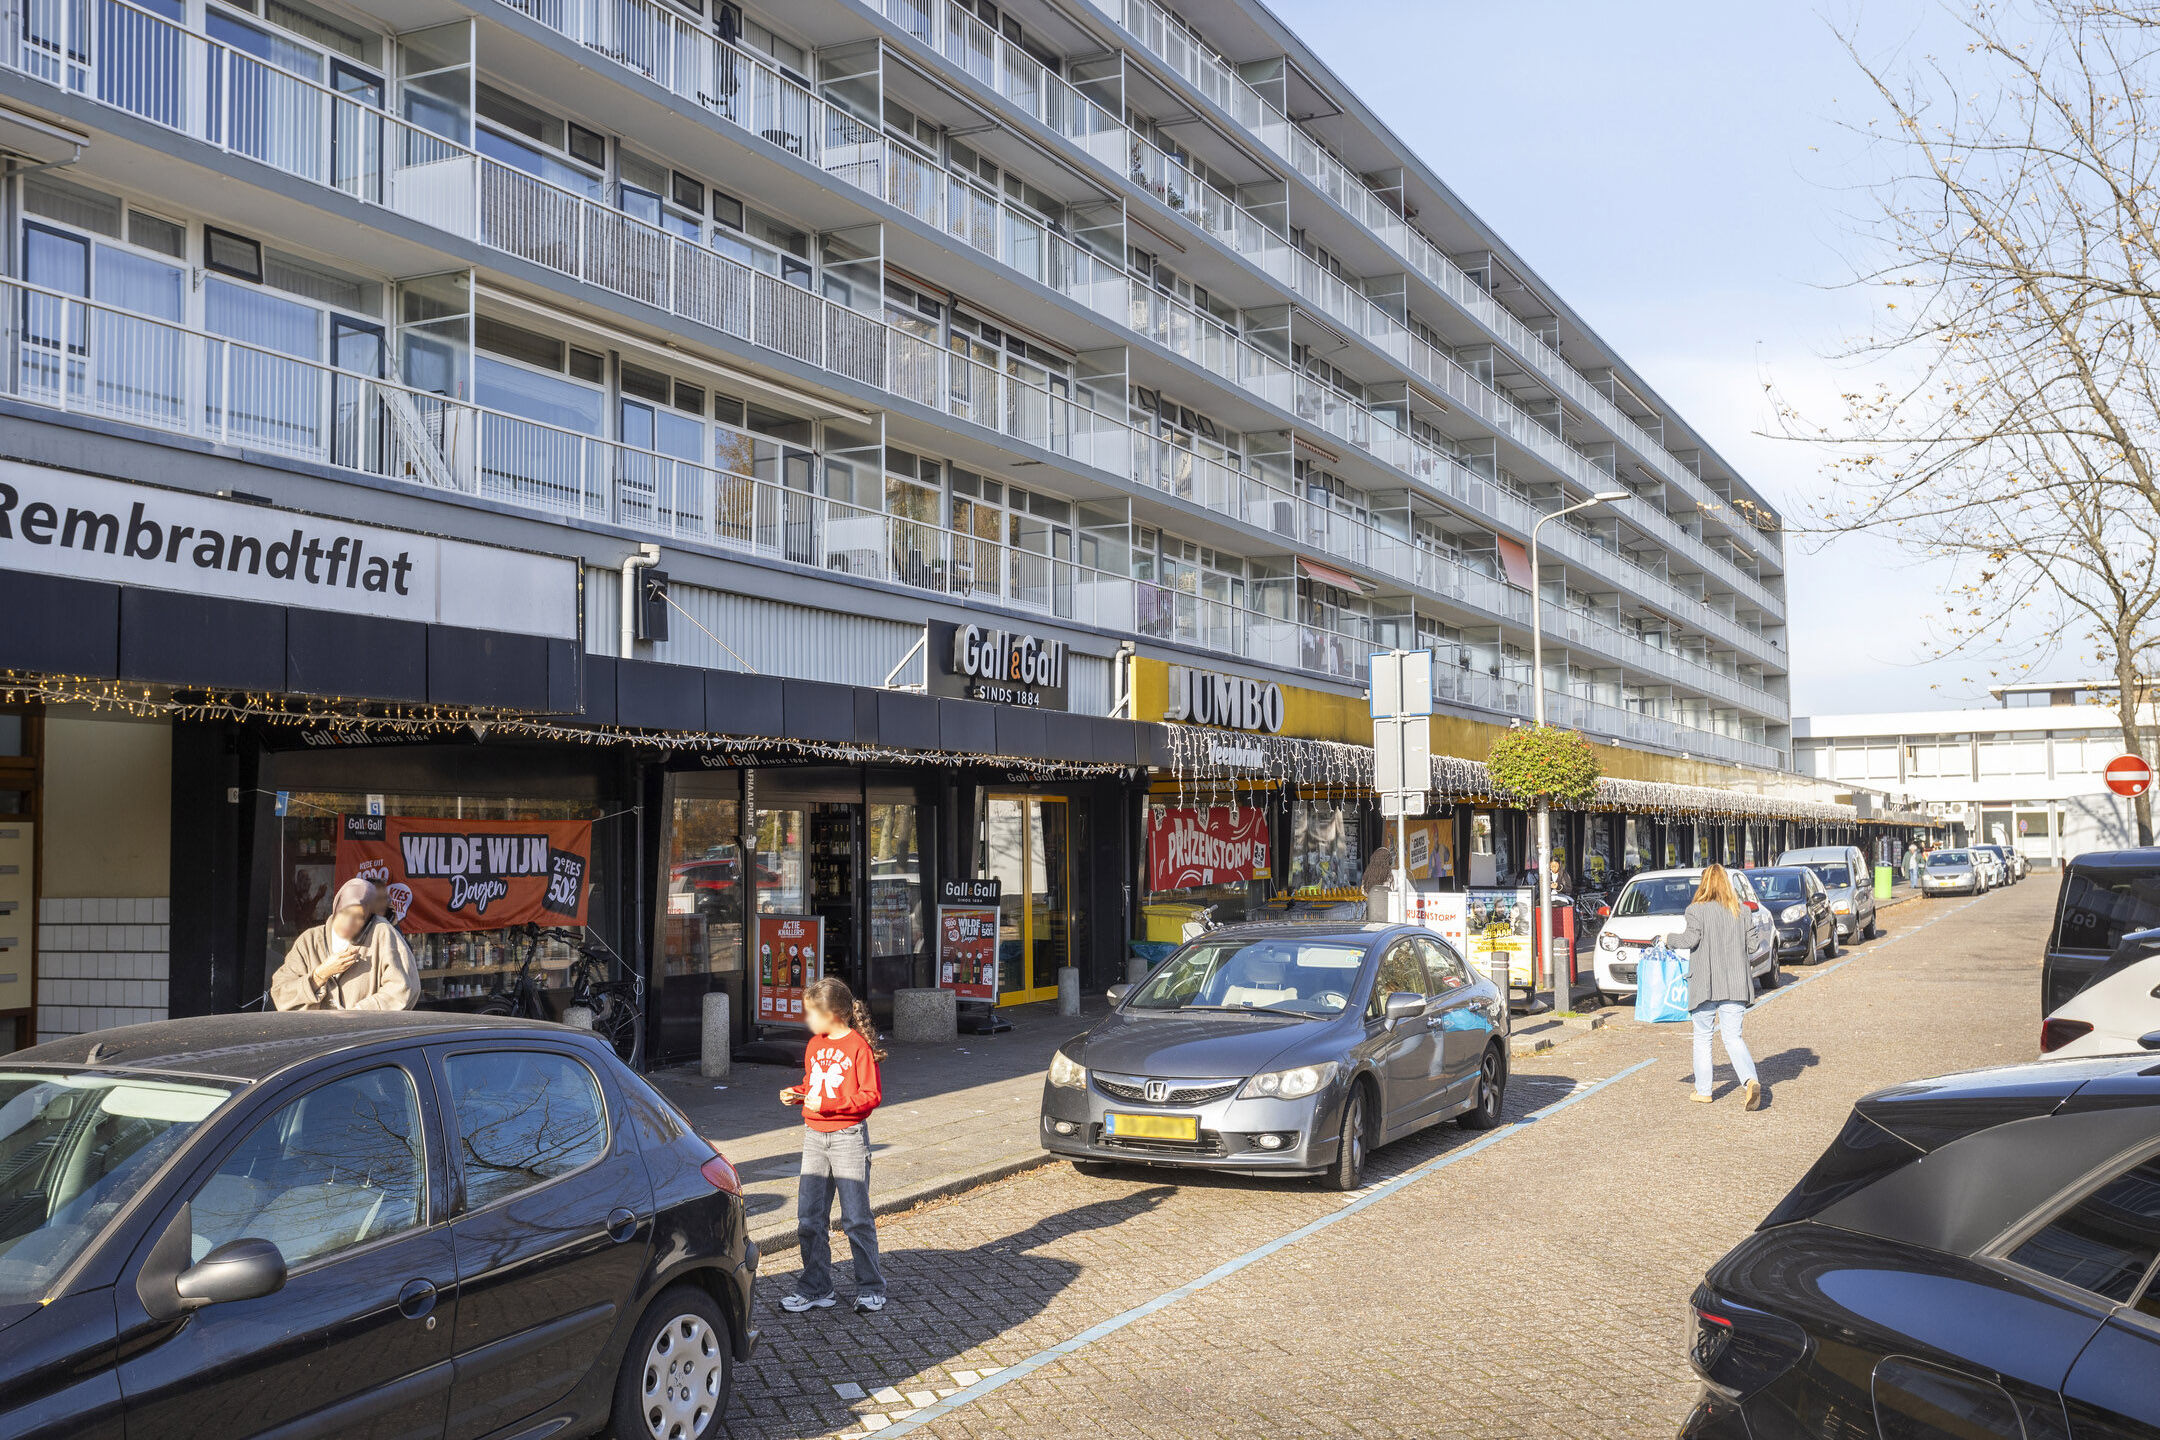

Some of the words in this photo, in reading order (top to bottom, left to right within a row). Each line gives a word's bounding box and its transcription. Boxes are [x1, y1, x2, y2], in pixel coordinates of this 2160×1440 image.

[0, 482, 413, 596] Rembrandtflat
[980, 686, 1012, 702] SINDS
[1016, 691, 1040, 706] 1884
[1170, 665, 1285, 733] JUMBO
[373, 735, 404, 744] SINDS
[405, 734, 430, 743] 1884
[760, 758, 787, 766] SINDS
[789, 757, 809, 765] 1884
[1184, 781, 1240, 792] JUMBO
[747, 769, 755, 827] AFHAALPUNT
[402, 836, 483, 875] WILDE
[486, 836, 549, 874] WIJN
[1167, 820, 1252, 875] PRIJZENSTORM
[390, 887, 411, 903] KIES
[451, 874, 507, 912] Dagen
[548, 875, 578, 908] 50%
[958, 918, 981, 929] WILDE
[1406, 909, 1457, 922] RIJZENSTORM
[782, 921, 801, 930] ACTIE
[959, 926, 979, 937] WIJN
